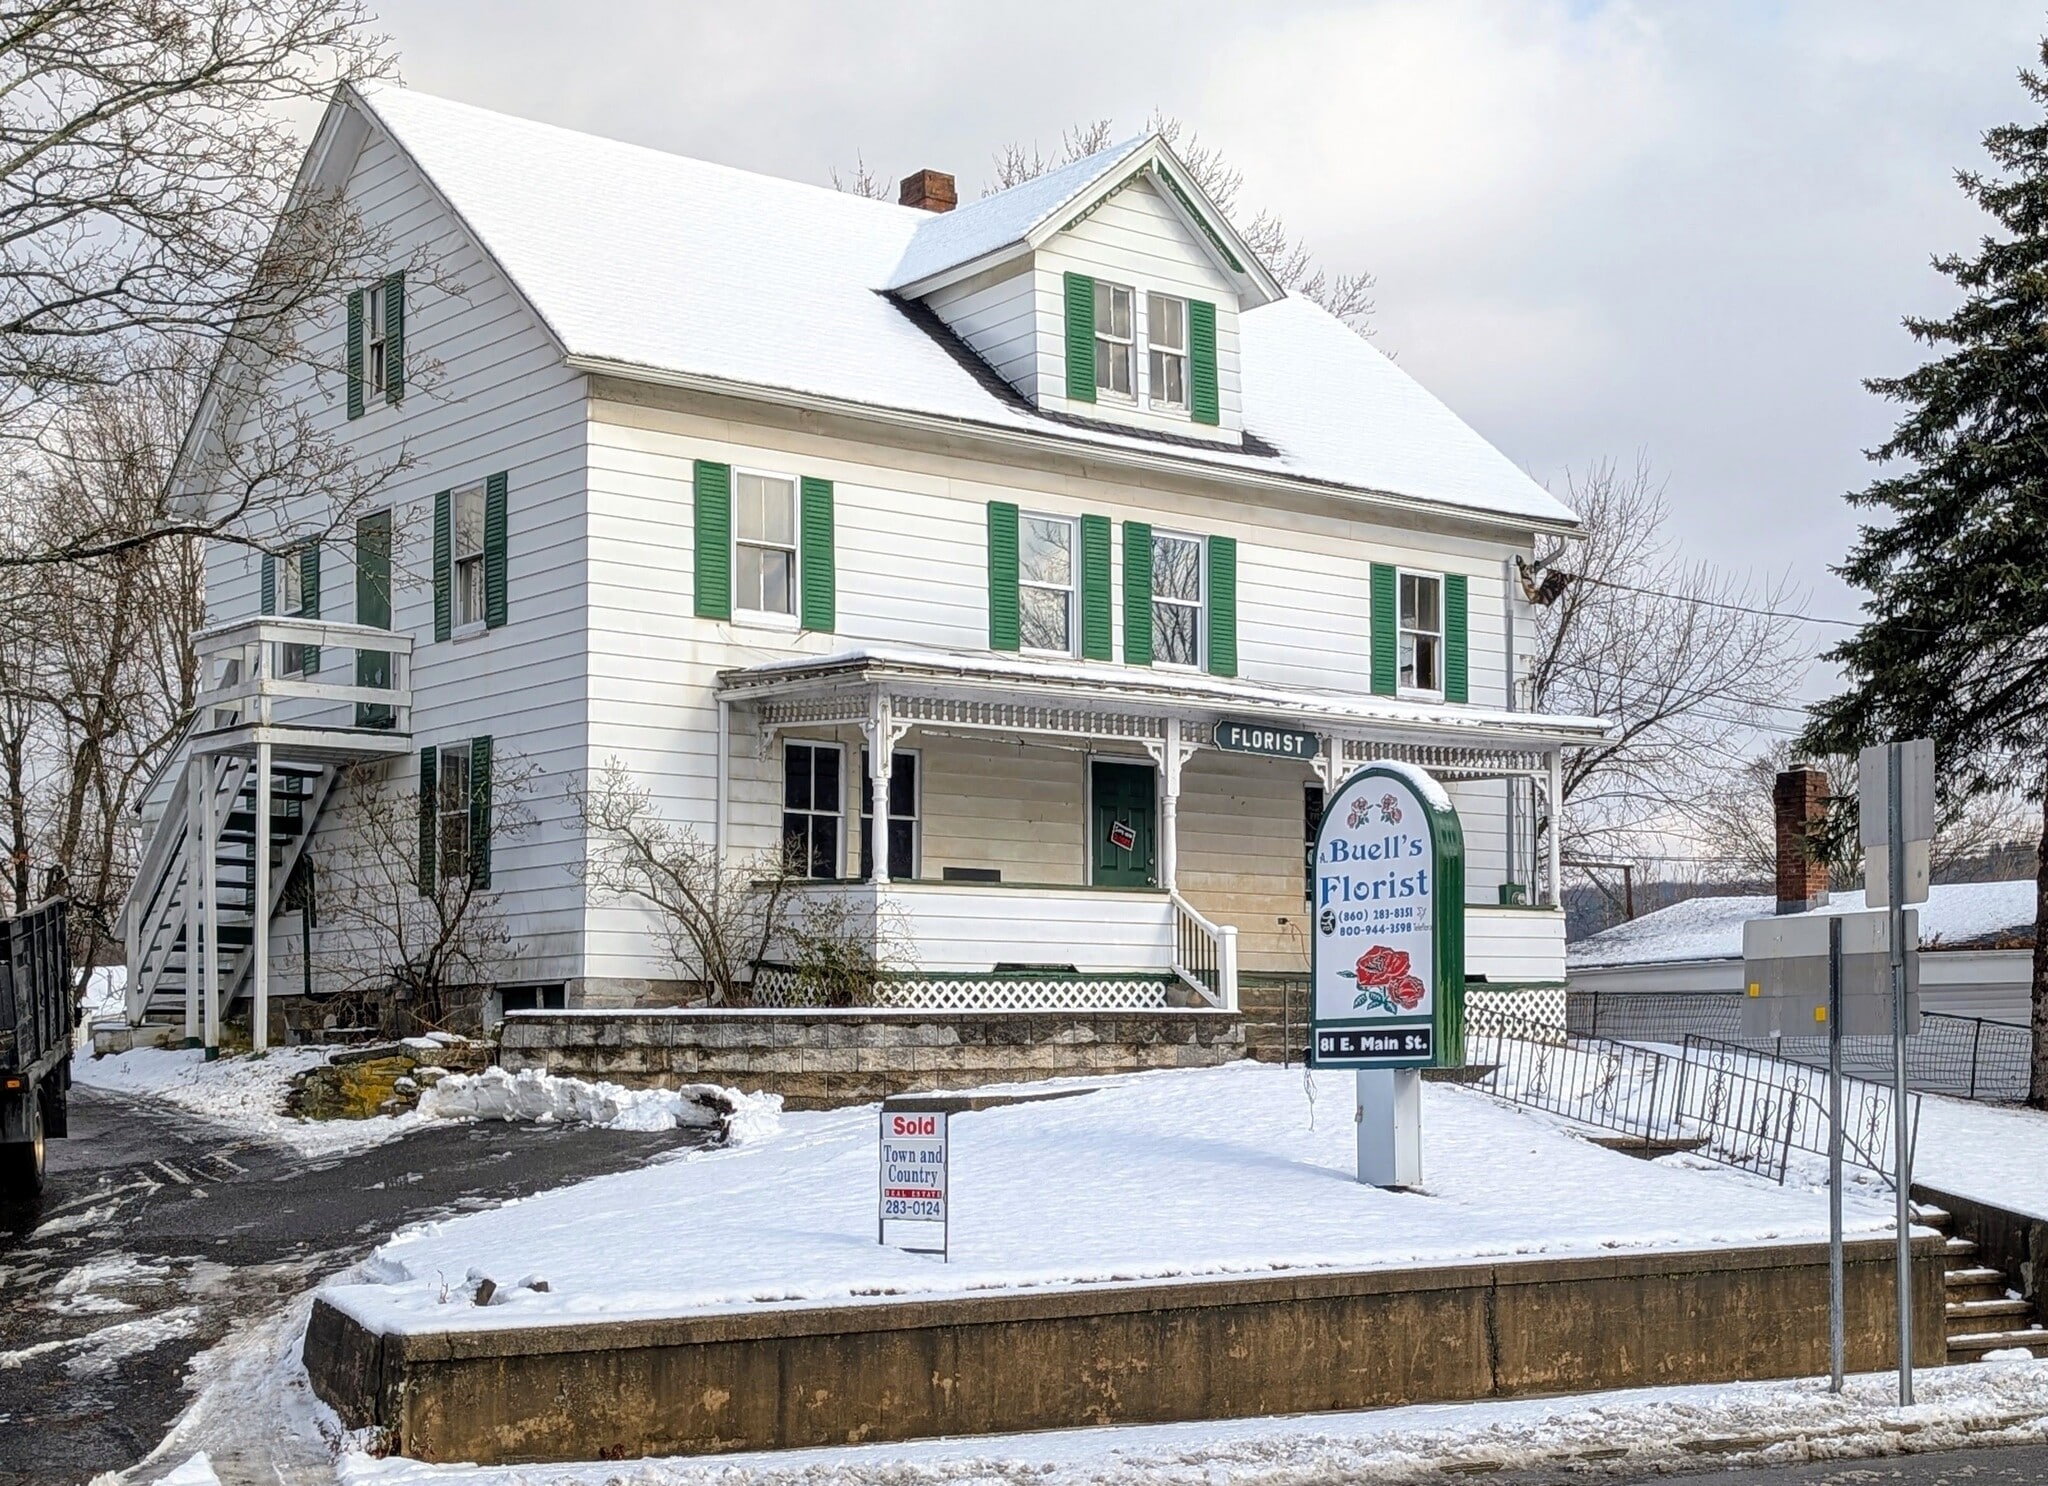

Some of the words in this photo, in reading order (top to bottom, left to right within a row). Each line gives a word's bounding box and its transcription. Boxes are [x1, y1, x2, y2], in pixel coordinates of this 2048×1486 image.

[1231, 727, 1304, 754] FLORIST
[1329, 834, 1423, 863] Buell's
[1320, 869, 1429, 909] Florist
[1338, 909, 1368, 923] (860)
[1373, 907, 1413, 920] 283-8351
[1340, 922, 1412, 936] 800-944-3598
[1320, 1038, 1334, 1052] 81
[1340, 1037, 1355, 1051] E.
[1360, 1036, 1399, 1051] Main
[1405, 1035, 1428, 1050] St.
[893, 1116, 935, 1135] Sold
[884, 1145, 916, 1163] Town
[920, 1146, 943, 1164] and
[888, 1164, 938, 1187] Country
[885, 1200, 941, 1216] 283-0124
